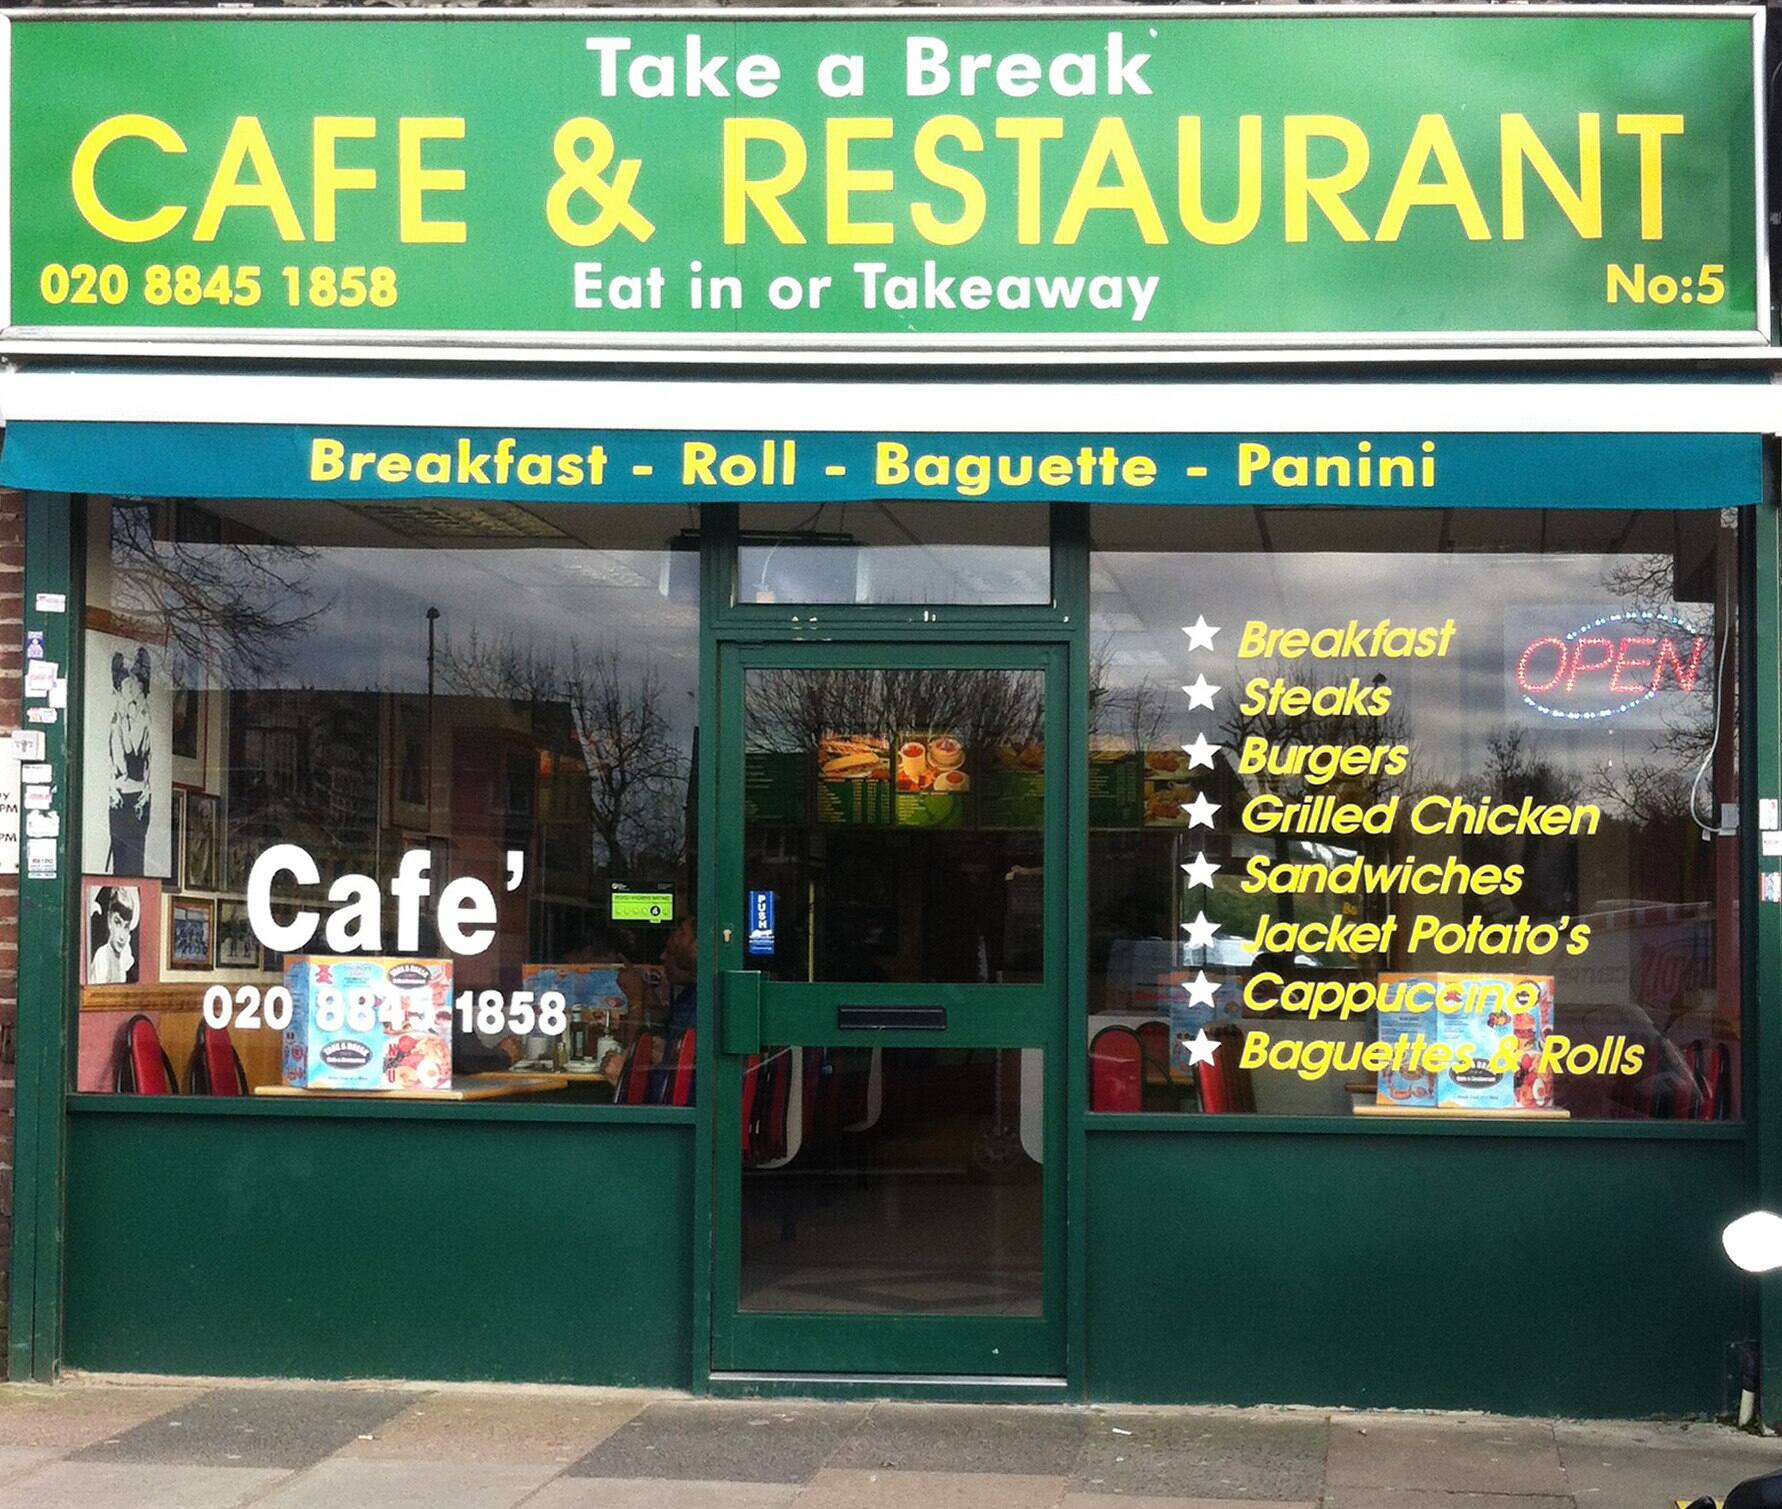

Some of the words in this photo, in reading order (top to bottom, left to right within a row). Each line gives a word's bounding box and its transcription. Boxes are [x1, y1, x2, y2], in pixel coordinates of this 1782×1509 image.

[585, 34, 781, 99] Take
[817, 54, 865, 98] a
[905, 31, 1153, 98] Break
[71, 113, 467, 244] CAFE
[545, 119, 655, 248] &
[722, 113, 1685, 247] RESTAURANT
[40, 263, 129, 305] 020
[143, 264, 262, 307] 8845
[281, 265, 398, 308] 1858
[574, 262, 665, 310] Eat
[690, 260, 742, 309] in
[768, 276, 832, 310] or
[853, 260, 1160, 321] Takeaway
[1606, 263, 1725, 305] No:5
[311, 438, 606, 486] Breakfast
[683, 440, 796, 485] Roll
[875, 442, 1156, 496] Baguette
[1239, 441, 1435, 487] Panini
[1237, 618, 1457, 660] Breakfast
[1516, 635, 1703, 694] OPEN
[1240, 677, 1392, 717] Steaks
[1237, 737, 1409, 785] Burgers
[1241, 793, 1396, 835] Grilled
[1410, 794, 1601, 836] Chicken
[1240, 855, 1524, 895] Sandwiches
[757, 894, 767, 929] PUSH
[1242, 914, 1398, 955] Jacket
[202, 985, 293, 1030] 020
[455, 990, 567, 1036] 1858
[1242, 971, 1539, 1021] Cappuccino
[1239, 1030, 1475, 1081] Baguettes
[1490, 1034, 1524, 1074] &
[1538, 1035, 1645, 1081] Rolls
